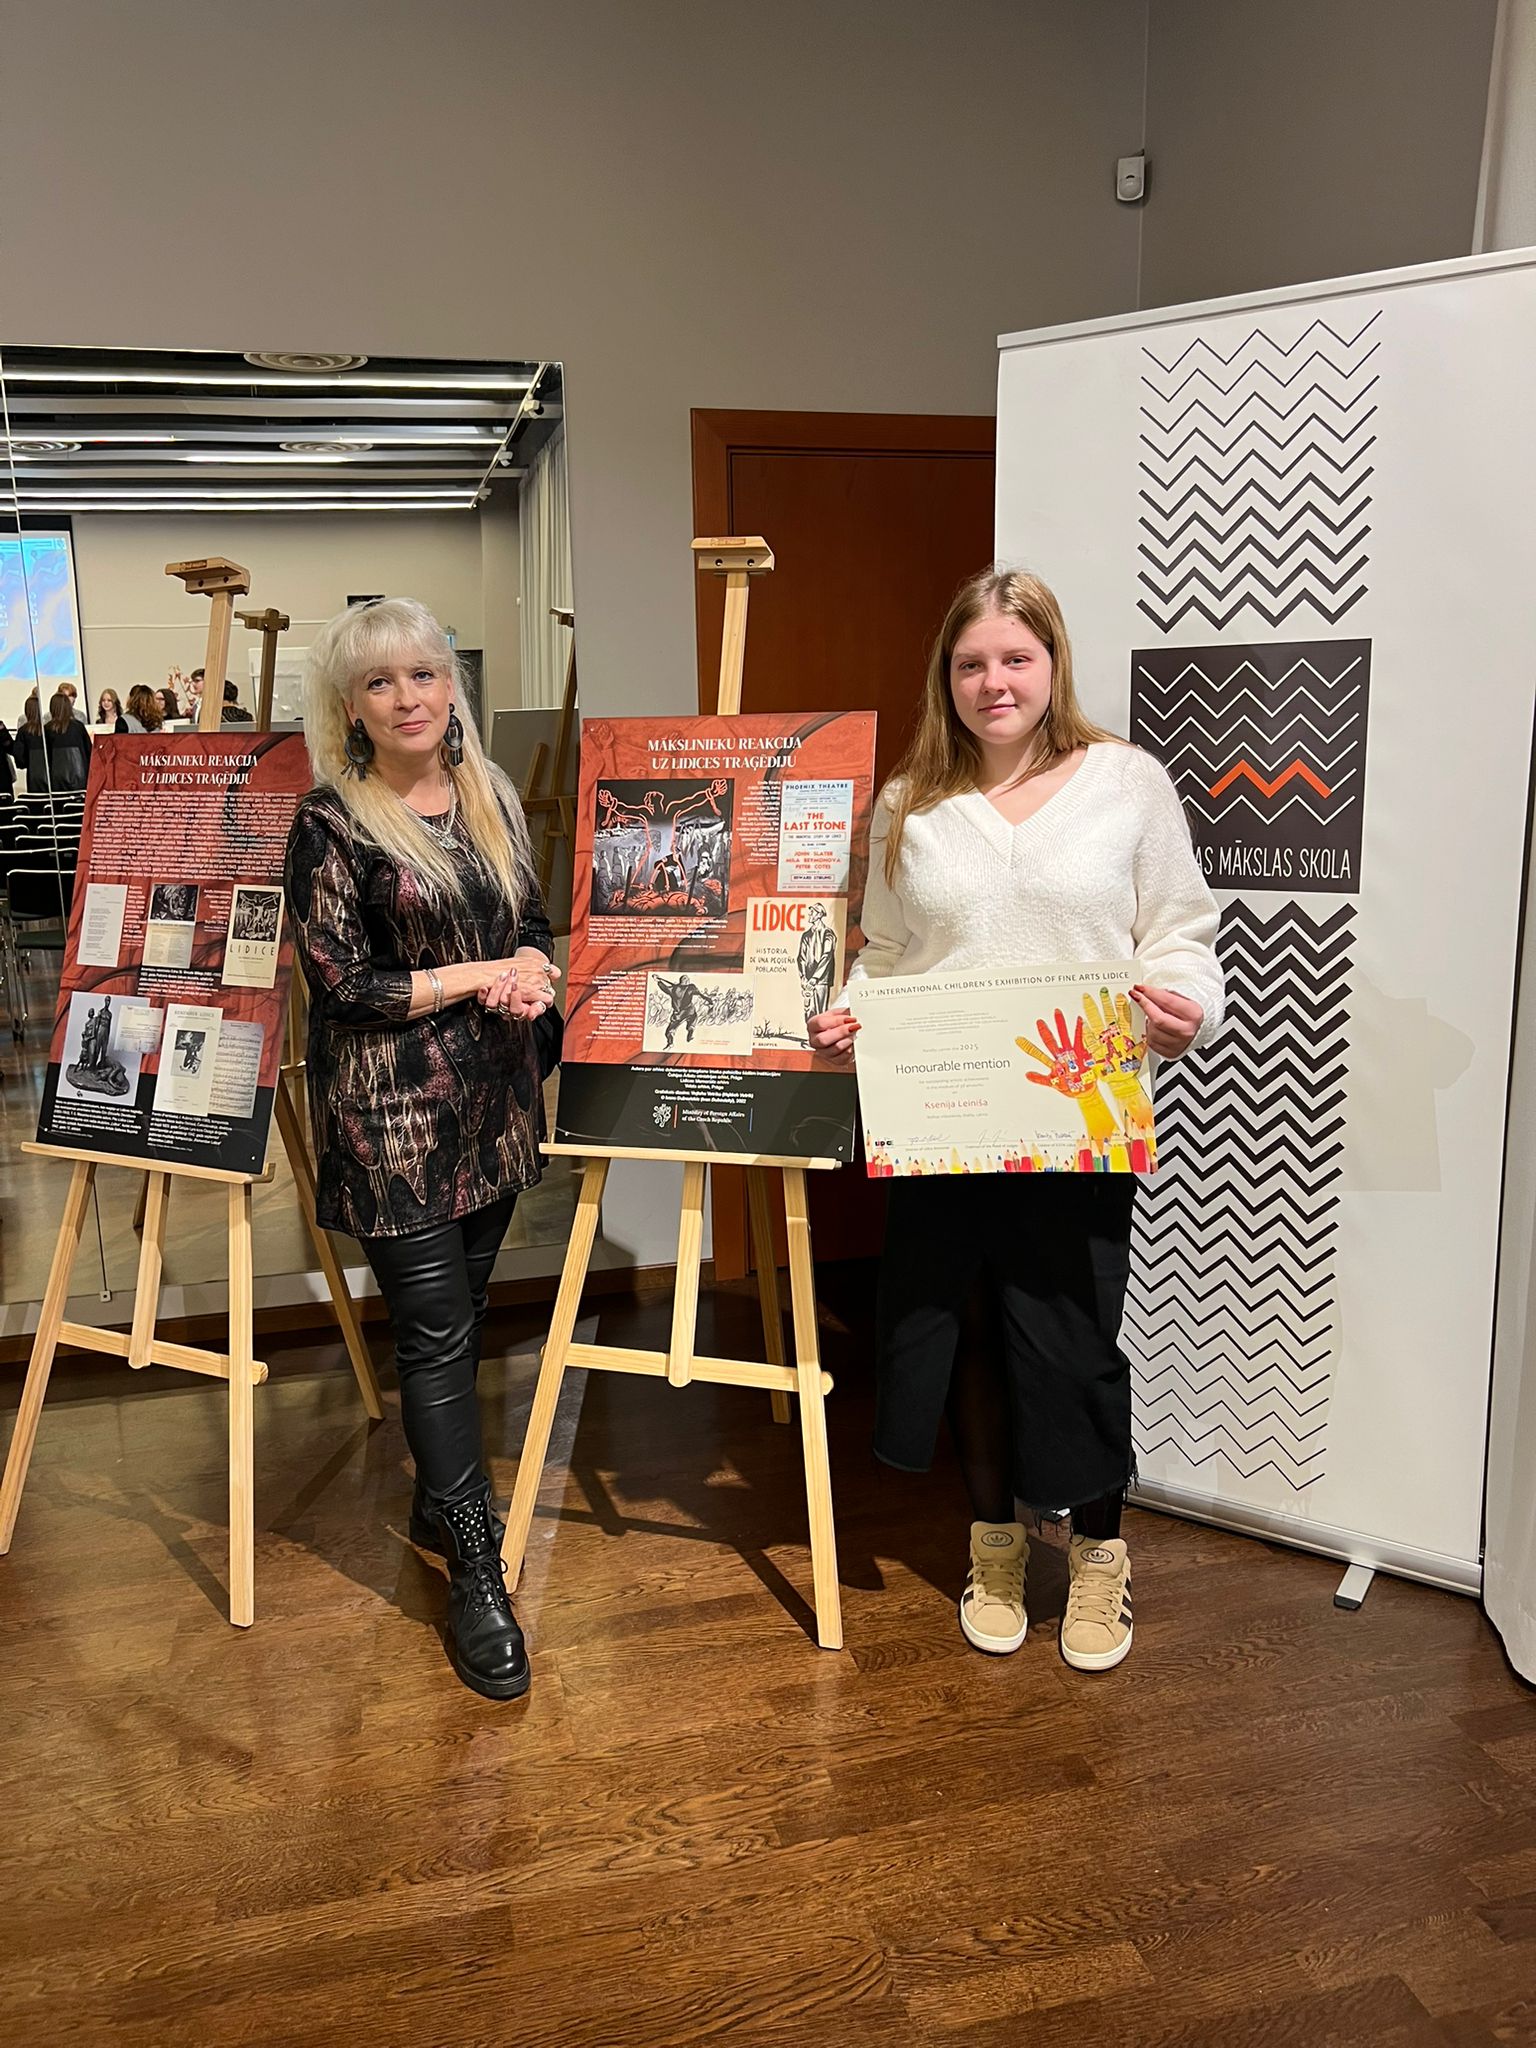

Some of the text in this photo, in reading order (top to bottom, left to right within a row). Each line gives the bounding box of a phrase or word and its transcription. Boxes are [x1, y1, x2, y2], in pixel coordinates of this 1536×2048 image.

[648, 737, 802, 752] MĀKSLINIEKU REAKCIJA
[139, 754, 258, 767] MĀKSLINIEKU REAKCIJA
[652, 755, 797, 772] UZ LIDICES TRAĢĒDIJU
[141, 772, 253, 787] UZ LIDICES TRAĢĒDIJU
[807, 812, 824, 820] THE
[784, 821, 847, 831] LAST STONE
[1219, 839, 1293, 878] MĀKSLAS
[1299, 848, 1351, 879] SKOLA
[753, 899, 807, 932] LÍDICE
[230, 943, 275, 956] LIDICE
[770, 955, 796, 964] PEQUEÑA
[877, 984, 942, 996] INTERNATIONAL
[944, 979, 993, 991] CHILDREN'S
[995, 976, 1042, 986] EXHIBITION
[1044, 975, 1055, 983] OF
[1058, 974, 1076, 982] FINE
[1079, 973, 1100, 981] ARTS
[1102, 971, 1129, 980] LIDICE
[960, 1043, 979, 1051] 2025
[895, 1058, 1011, 1075] Honourable mention
[924, 1100, 956, 1110] Ksenija
